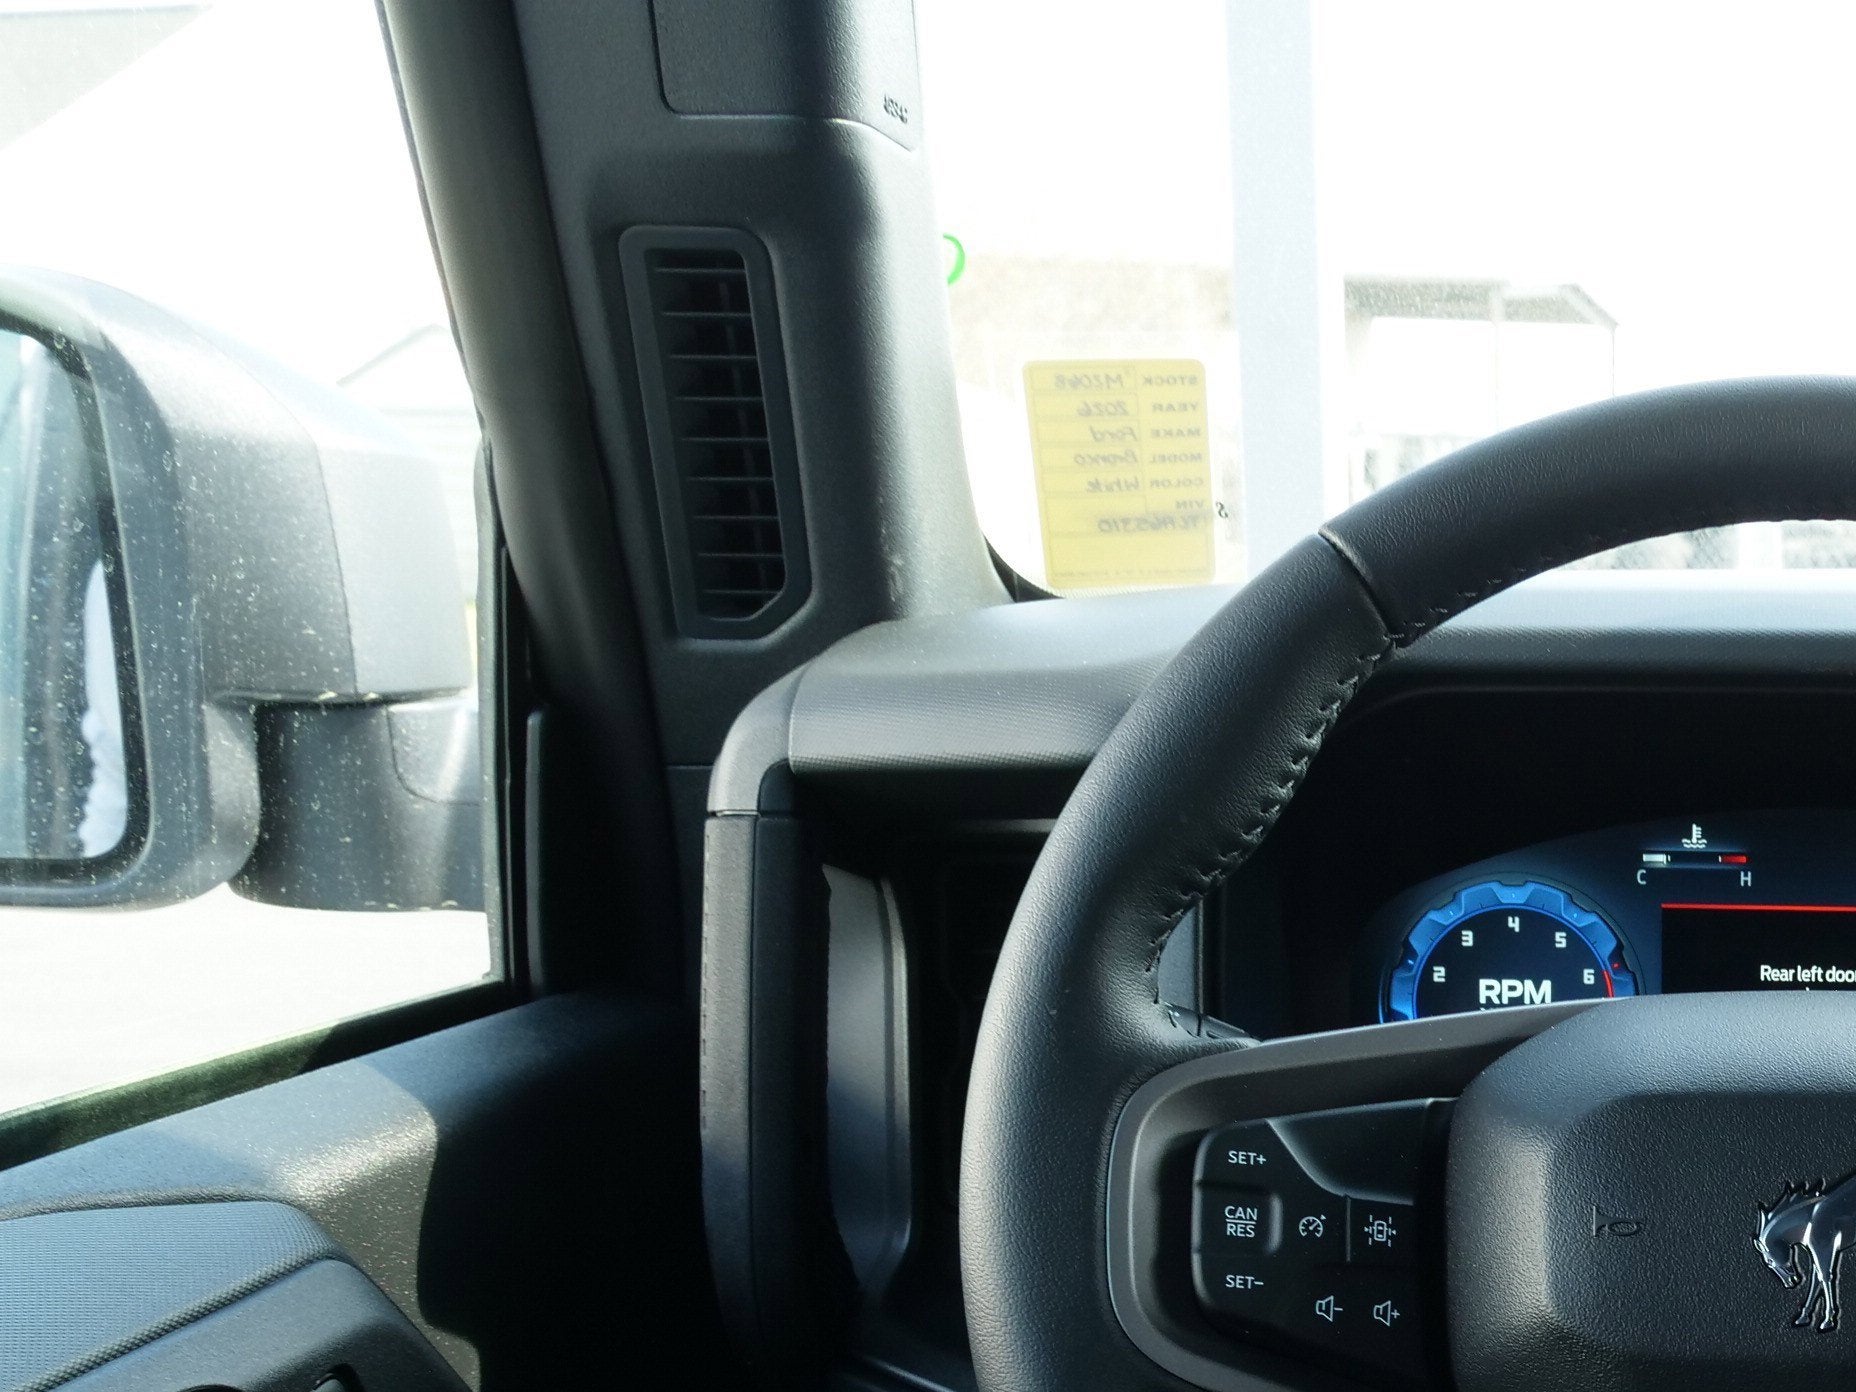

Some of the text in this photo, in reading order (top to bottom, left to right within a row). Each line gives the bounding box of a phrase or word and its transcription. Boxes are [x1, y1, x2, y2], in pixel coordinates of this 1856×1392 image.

[1636, 869, 1647, 885] C
[1740, 871, 1752, 887] H
[1507, 916, 1520, 932] 4
[1461, 930, 1474, 947] 3
[1555, 932, 1567, 948] 5
[1432, 966, 1446, 983] 2
[1582, 968, 1595, 985] 6
[1760, 965, 1795, 982] Rear
[1796, 965, 1823, 982] left
[1478, 978, 1552, 1005] RPM
[1224, 1205, 1258, 1220] CAN
[1226, 1223, 1256, 1238] RES
